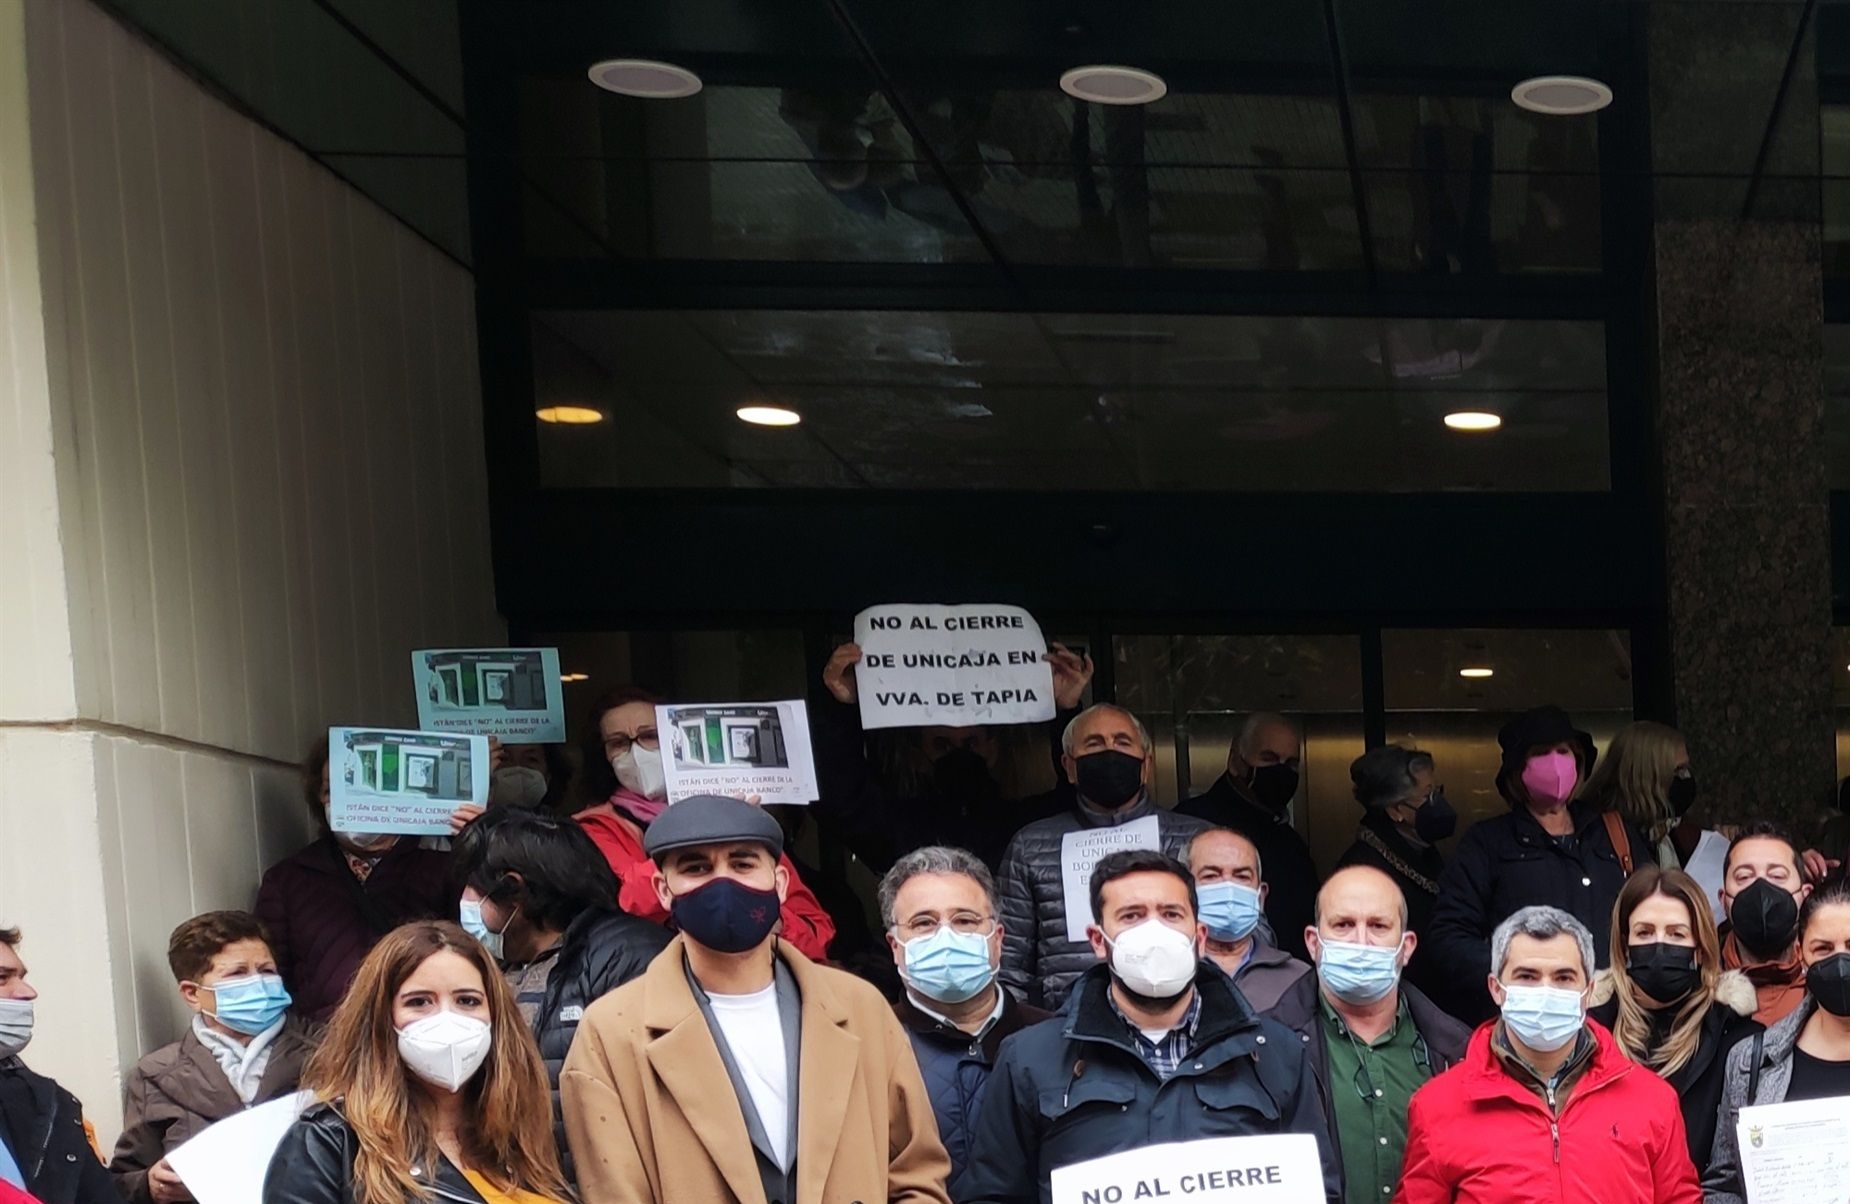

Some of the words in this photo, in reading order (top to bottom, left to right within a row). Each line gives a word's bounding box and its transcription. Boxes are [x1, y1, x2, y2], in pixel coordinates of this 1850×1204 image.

[870, 616, 902, 630] NO
[910, 616, 938, 630] AL
[944, 615, 1024, 631] CIERRE
[866, 654, 895, 668] DE
[903, 653, 1000, 668] UNICAJA
[1008, 651, 1037, 665] EN
[876, 693, 929, 706] VVA.
[937, 692, 964, 706] DE
[971, 688, 1038, 705] TAPIA
[1075, 834, 1120, 848] CIERRE
[1124, 834, 1142, 844] DE
[1134, 1178, 1170, 1199] AL
[1180, 1166, 1282, 1194] CIERRE
